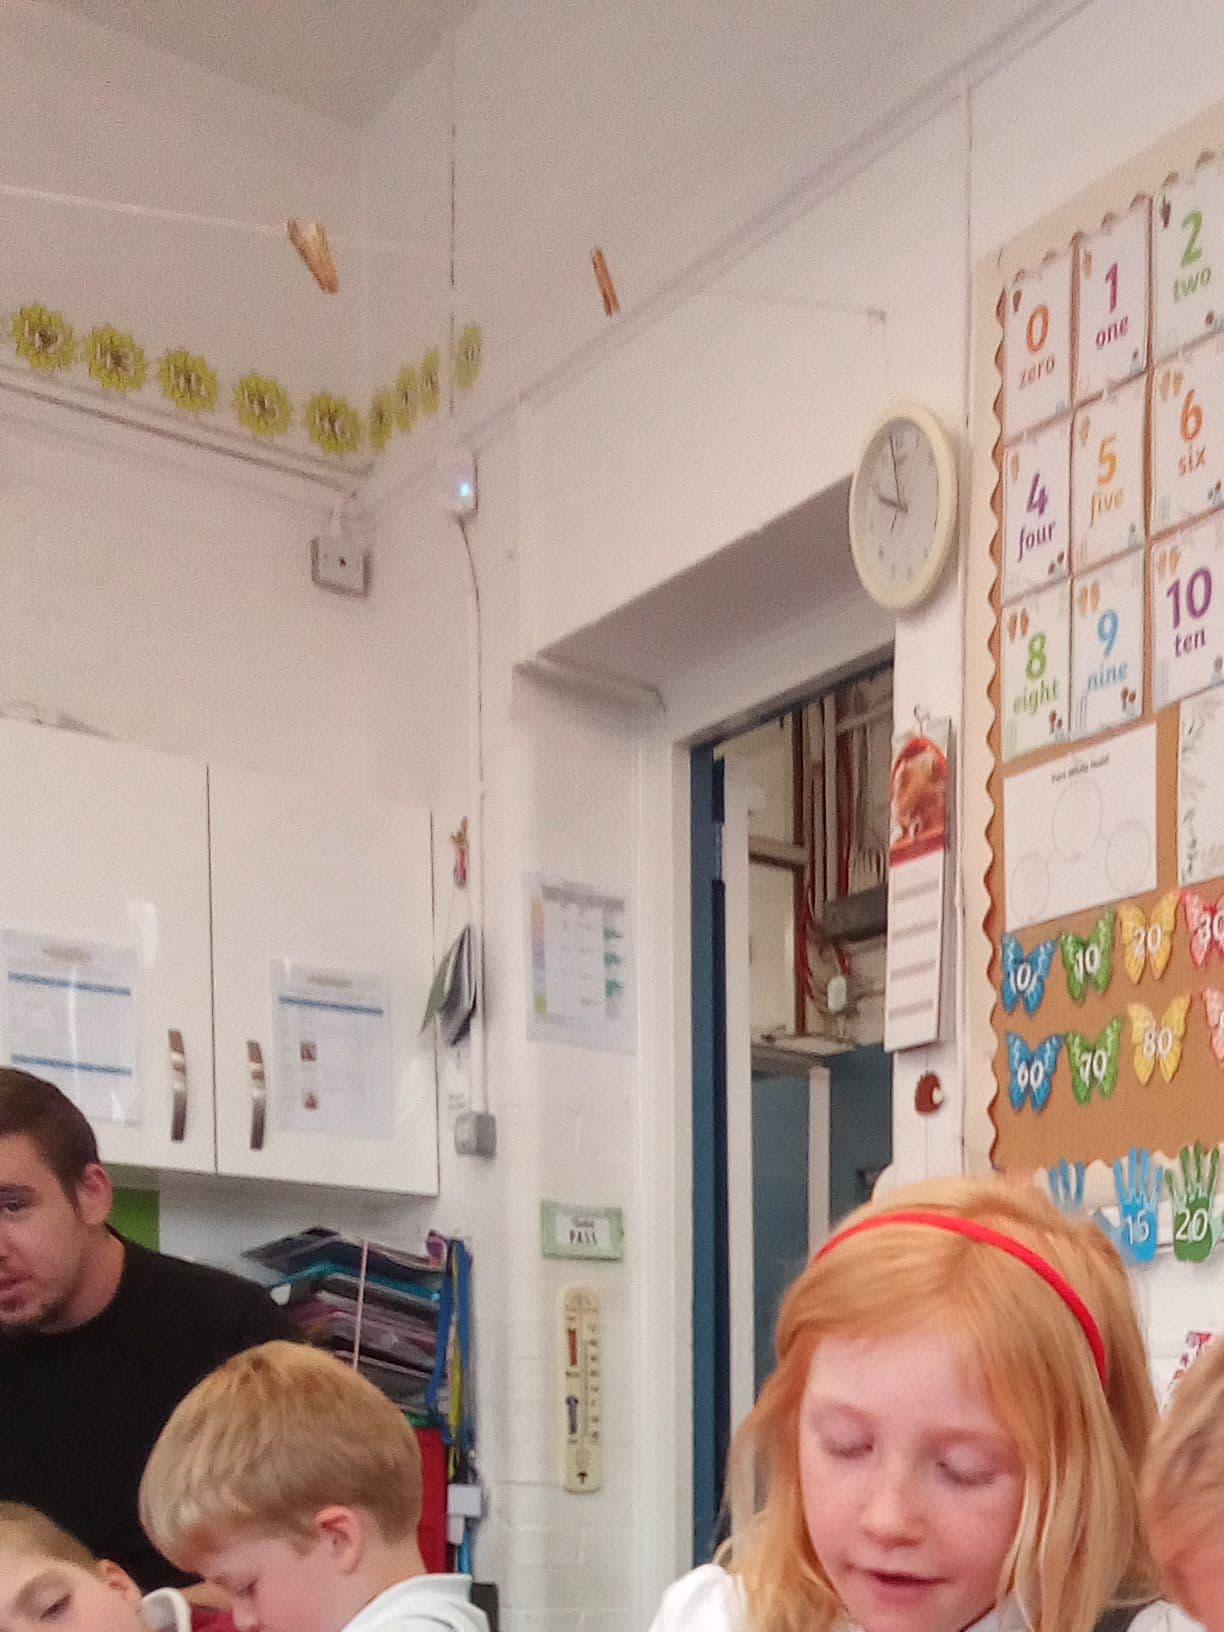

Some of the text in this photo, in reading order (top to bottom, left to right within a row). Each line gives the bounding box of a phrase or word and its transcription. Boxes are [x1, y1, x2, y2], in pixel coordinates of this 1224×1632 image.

[1181, 210, 1202, 267] 2
[1105, 262, 1118, 312] 1
[1027, 305, 1049, 352] 0
[1096, 315, 1128, 350] one
[1181, 389, 1202, 443] 6
[1097, 434, 1117, 486] 5
[1178, 447, 1206, 477] six
[1026, 473, 1048, 517] 4
[1017, 521, 1056, 563] four
[1166, 567, 1213, 630] 10
[1025, 633, 1046, 680] 8
[1097, 609, 1118, 658] 9
[1174, 628, 1206, 657] ten
[1013, 679, 1059, 715] eight
[1087, 660, 1129, 692] nine
[1074, 945, 1100, 983] 10
[1135, 923, 1162, 960] 20
[1080, 1050, 1109, 1088] 70
[1142, 1026, 1173, 1060] 80
[1125, 1213, 1149, 1245] 15
[1175, 1208, 1209, 1242] 20
